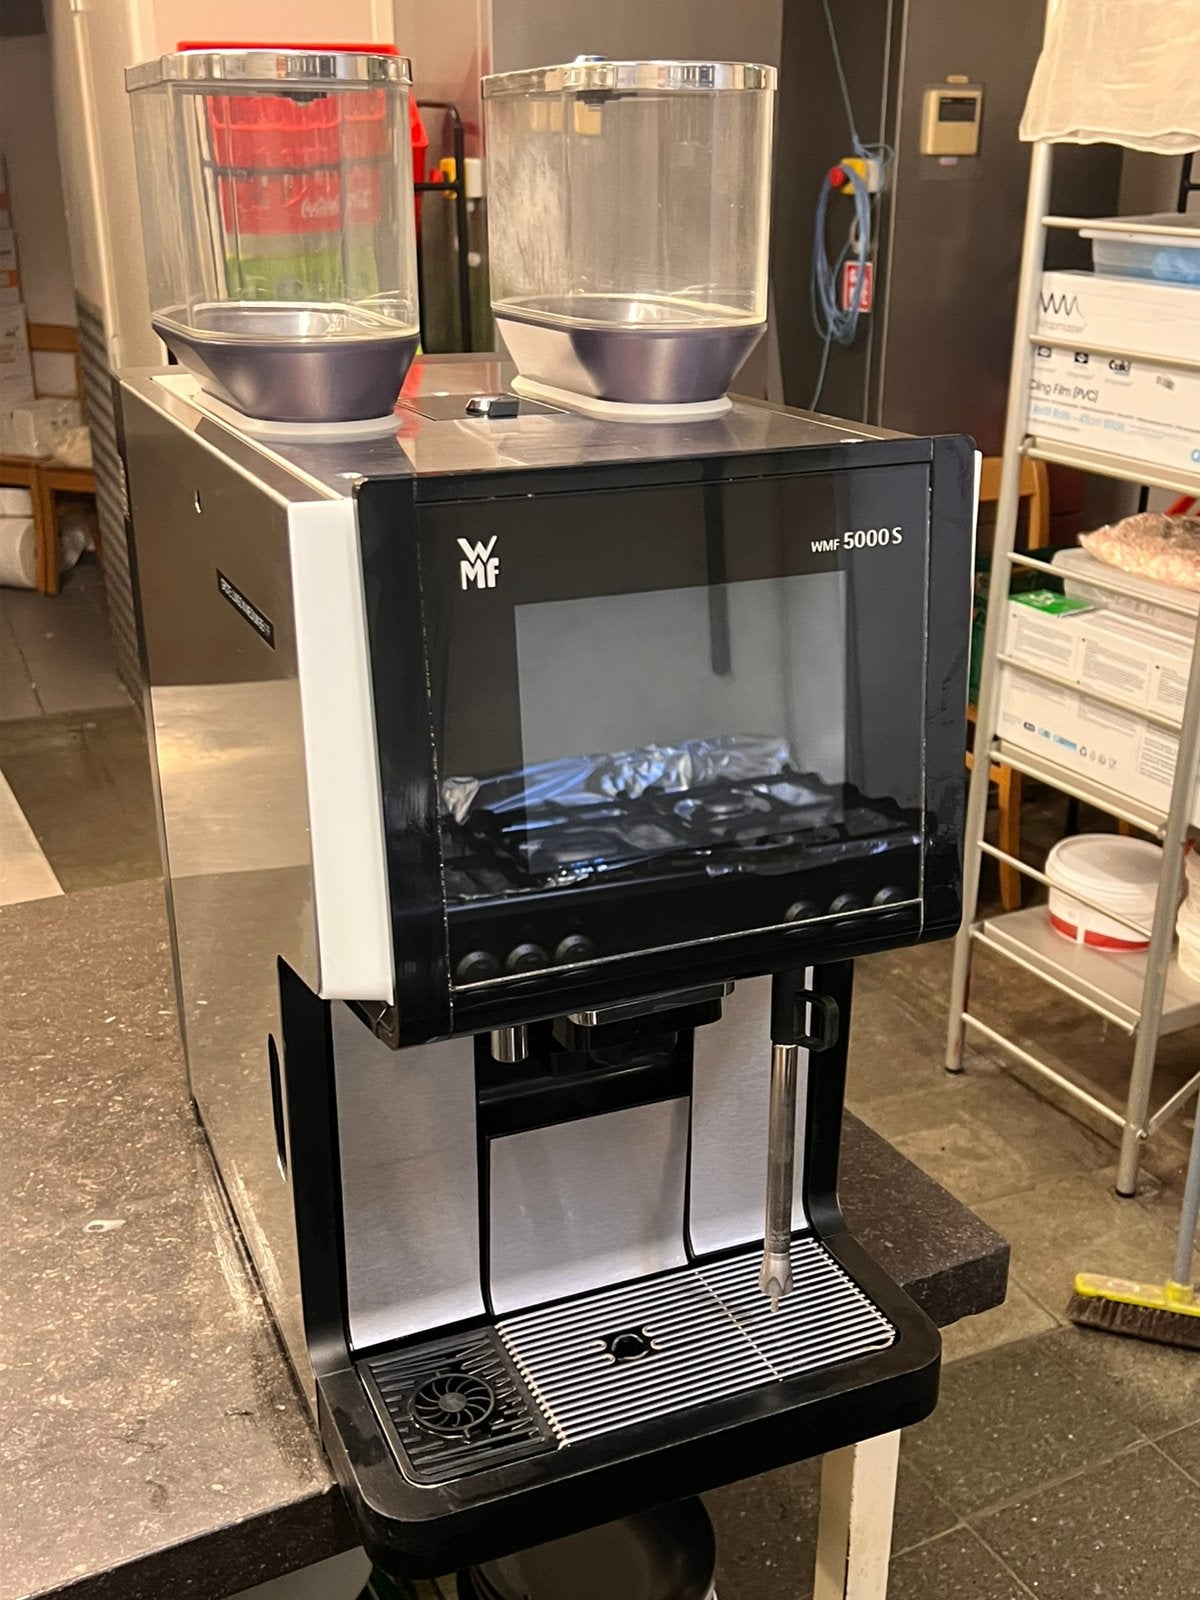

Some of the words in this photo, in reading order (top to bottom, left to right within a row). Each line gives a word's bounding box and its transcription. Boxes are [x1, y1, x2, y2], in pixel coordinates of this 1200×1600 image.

[811, 539, 840, 553] WMF
[843, 528, 889, 549] 5000
[892, 527, 903, 544] S
[457, 535, 499, 590] WMF
